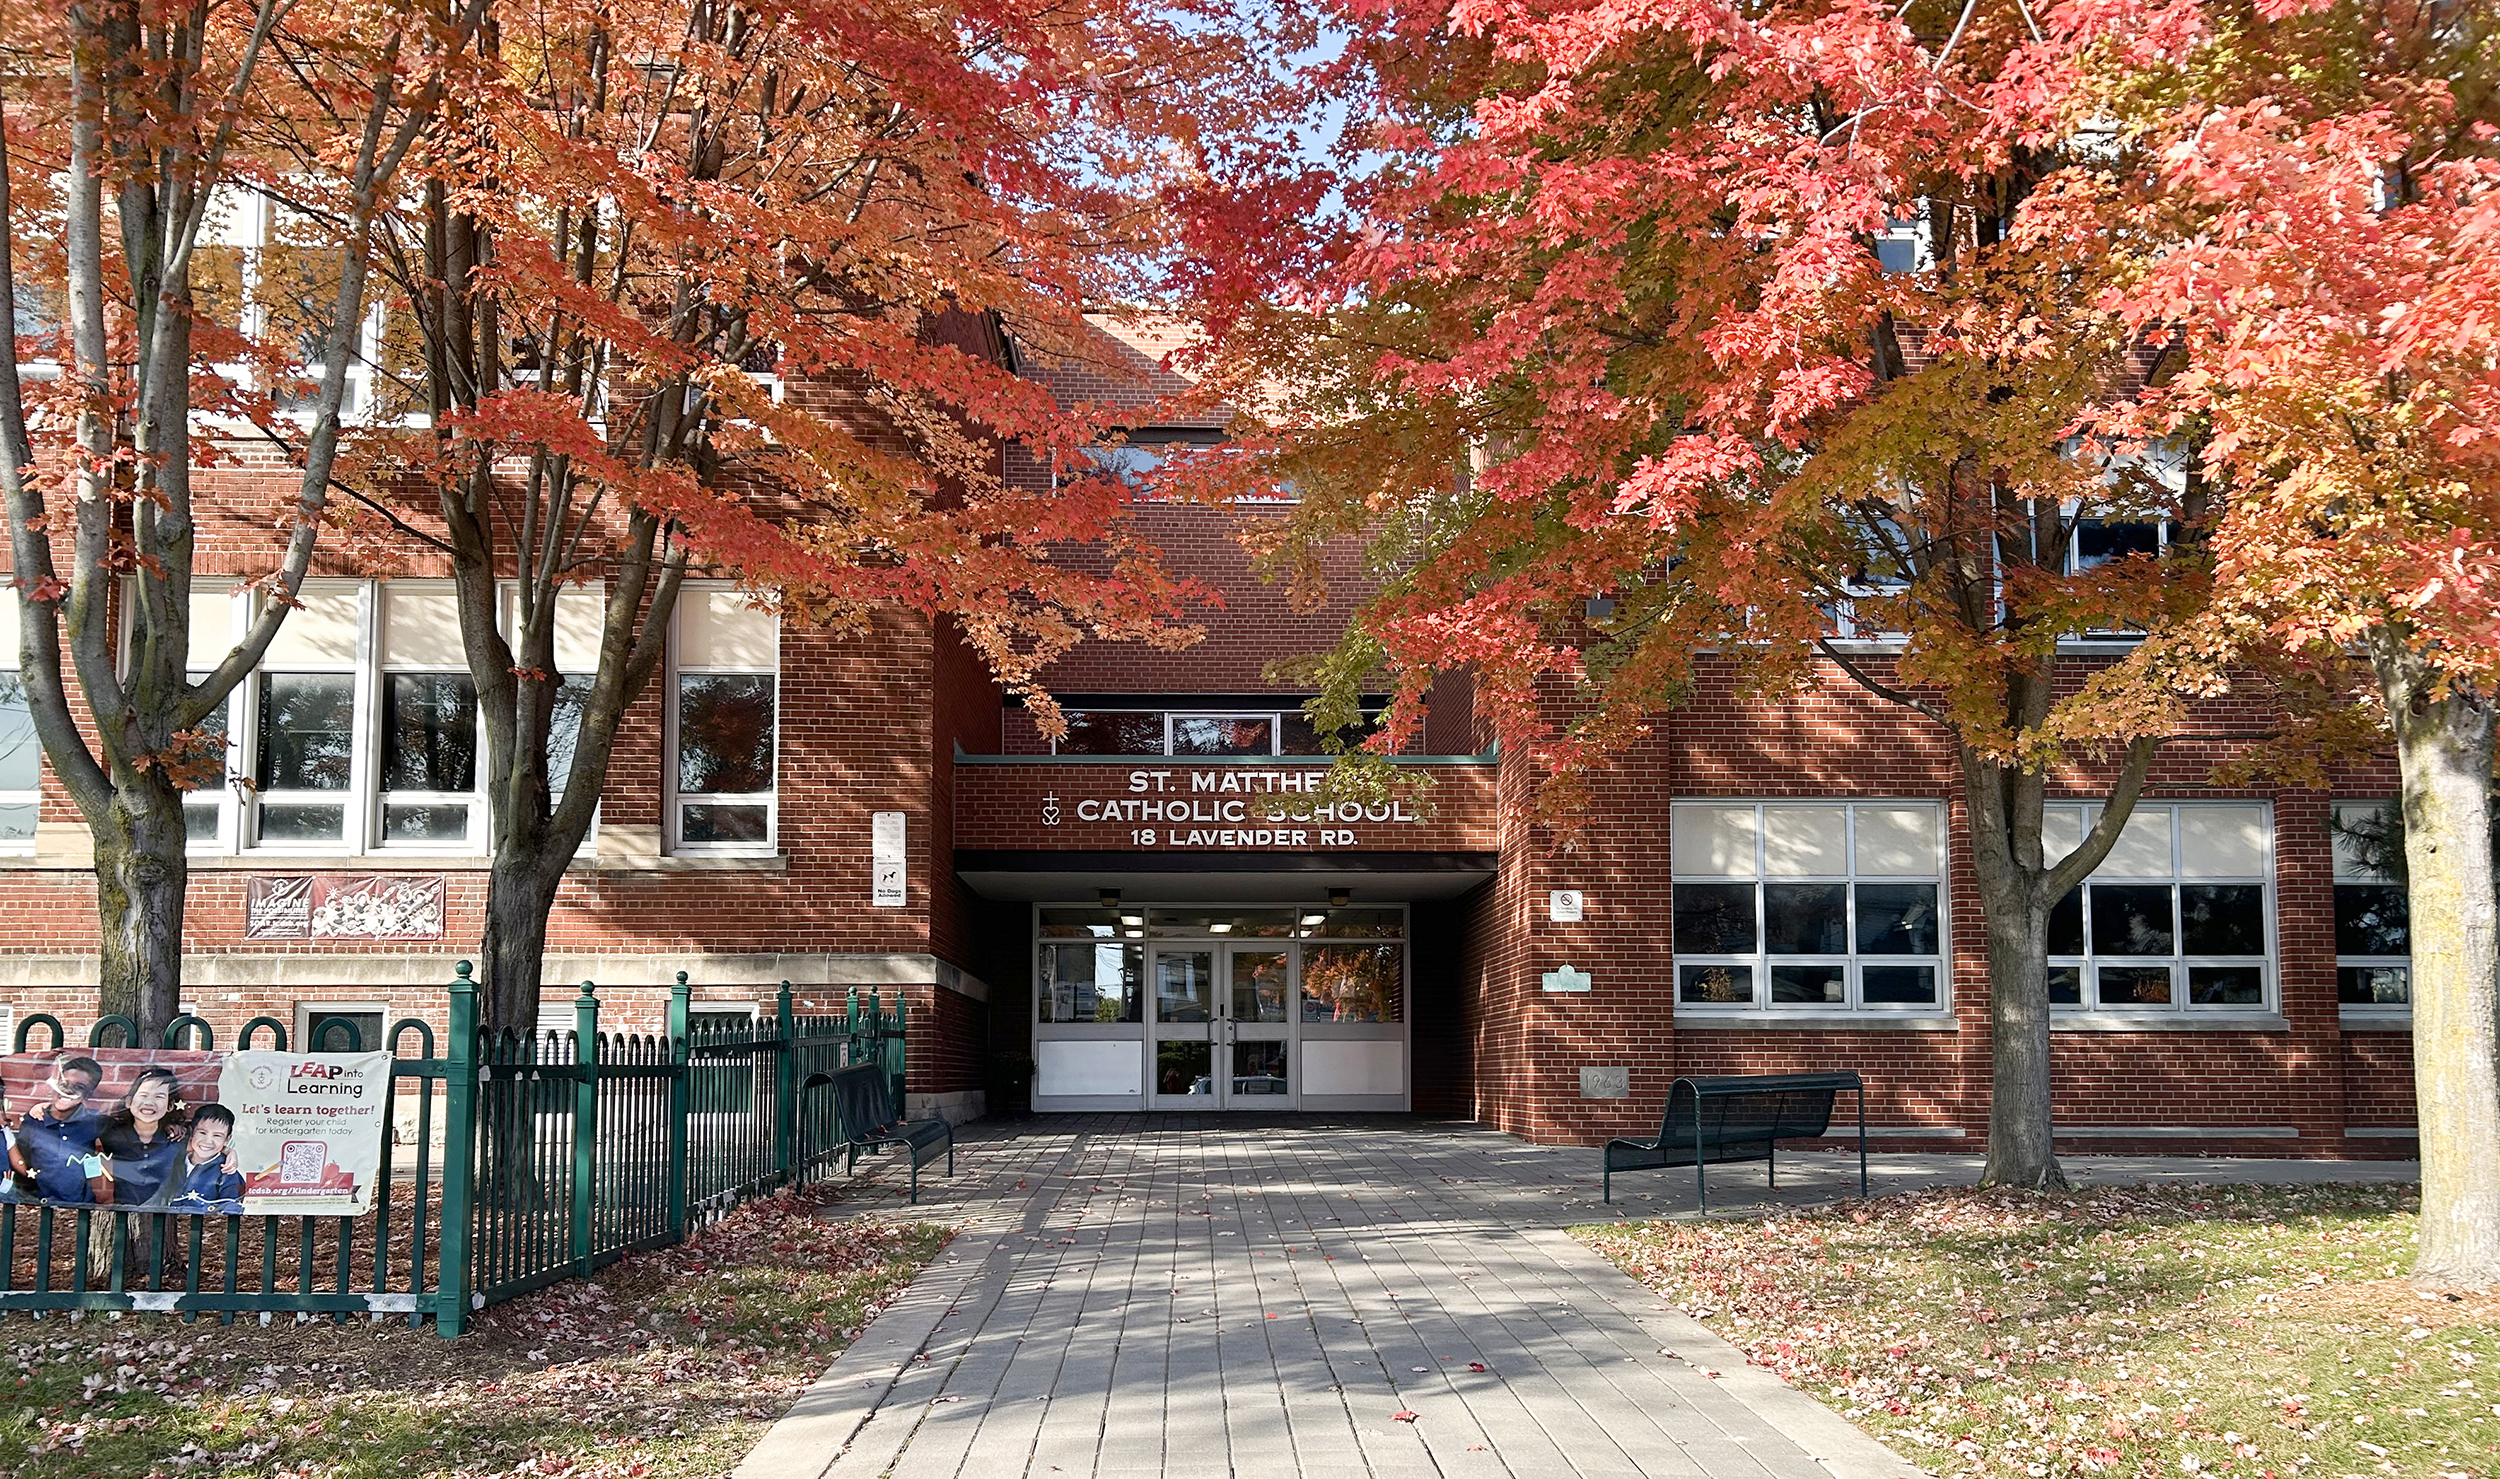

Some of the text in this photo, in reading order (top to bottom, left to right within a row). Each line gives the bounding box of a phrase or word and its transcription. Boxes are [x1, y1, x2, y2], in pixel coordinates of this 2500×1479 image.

[1128, 770, 1338, 793] ST. MATTHE
[1076, 799, 1246, 823] CATHOLIC
[1130, 828, 1359, 846] 18 LAVENDER RD.
[250, 898, 310, 908] IMAGINE
[289, 1061, 343, 1080] LEAP
[344, 1068, 364, 1078] into
[287, 1078, 363, 1099] Learning
[1585, 1074, 1625, 1089] 1963
[242, 1103, 375, 1117] Let's learn together!
[266, 1117, 303, 1126] Register
[326, 1117, 347, 1126] child
[255, 1127, 268, 1135] for
[269, 1127, 327, 1136] kindergarten
[247, 1186, 349, 1196] tcdsb.org/Kindergarten
